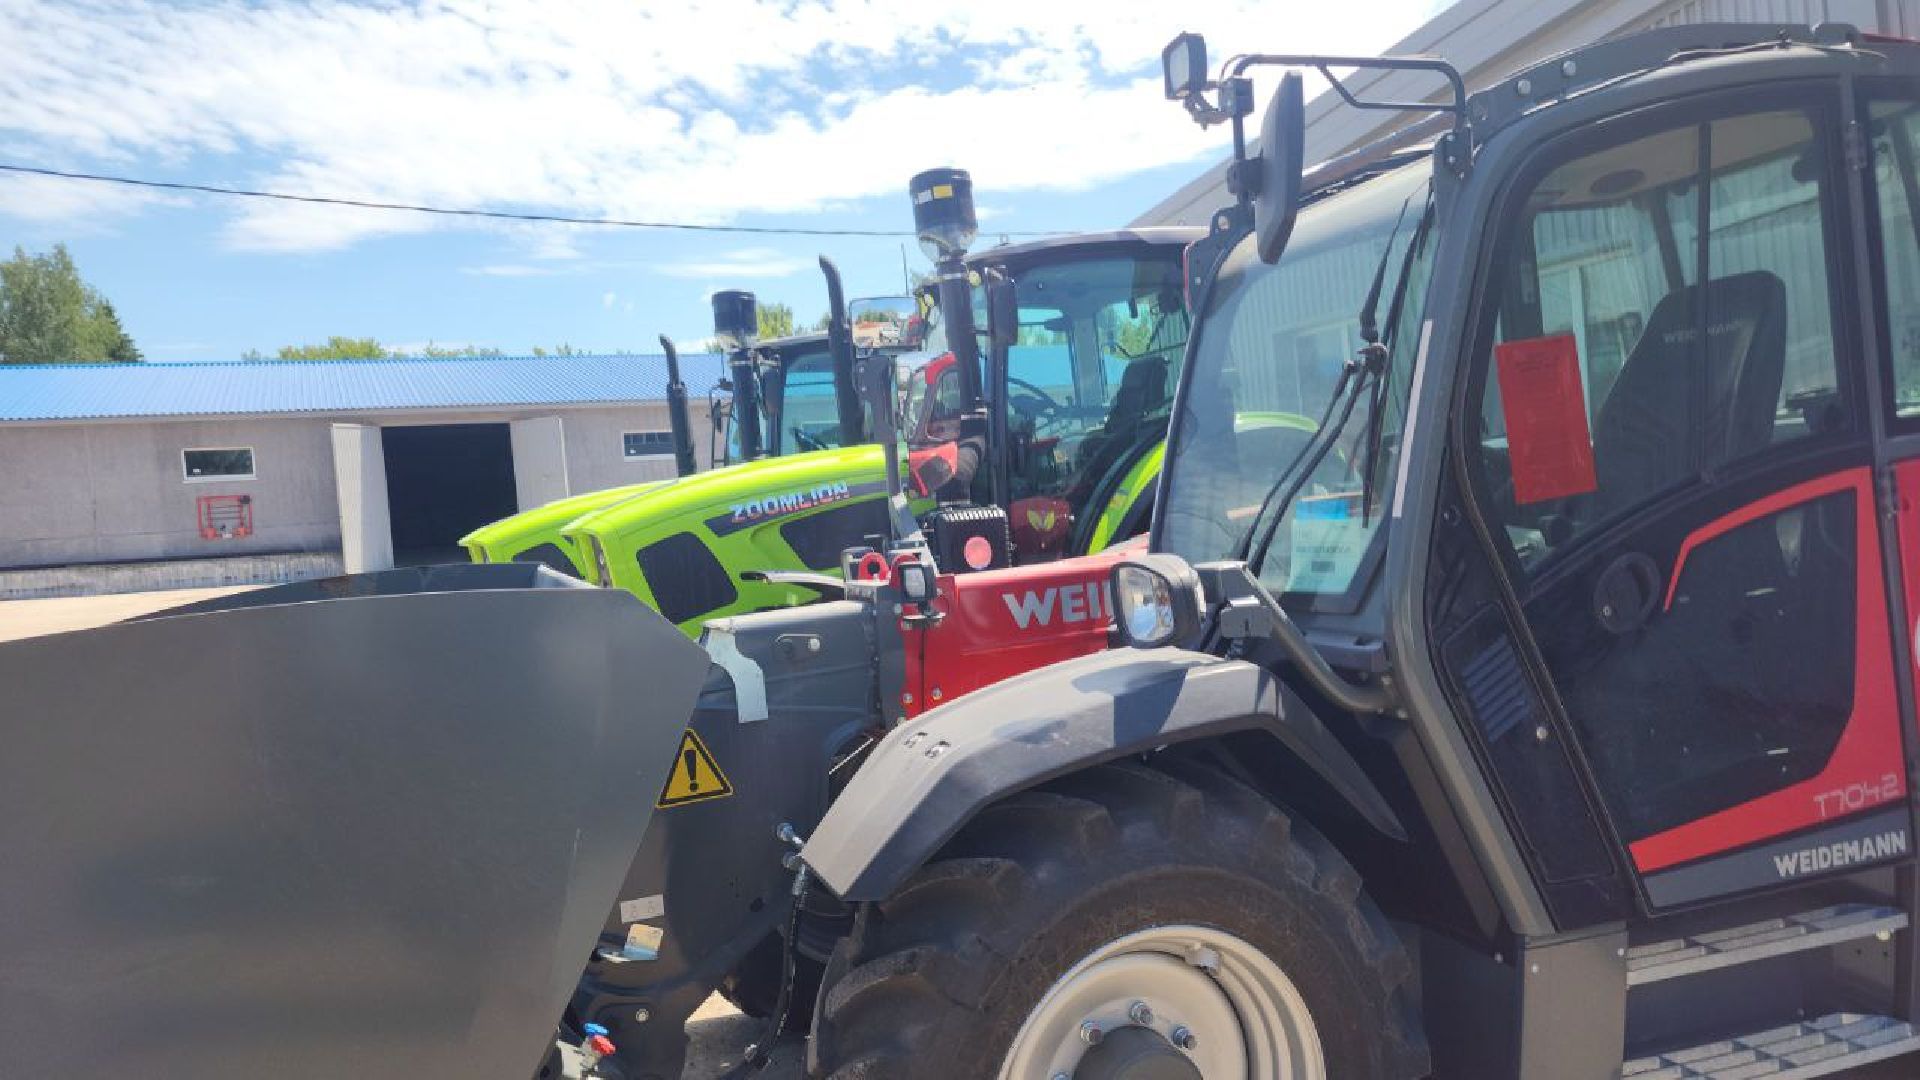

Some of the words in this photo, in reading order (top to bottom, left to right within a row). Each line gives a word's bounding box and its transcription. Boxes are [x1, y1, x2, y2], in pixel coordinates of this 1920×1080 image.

[729, 480, 850, 524] ZOOMLION
[1813, 774, 1902, 817] T7042
[1773, 828, 1907, 878] WEIDEMANN
